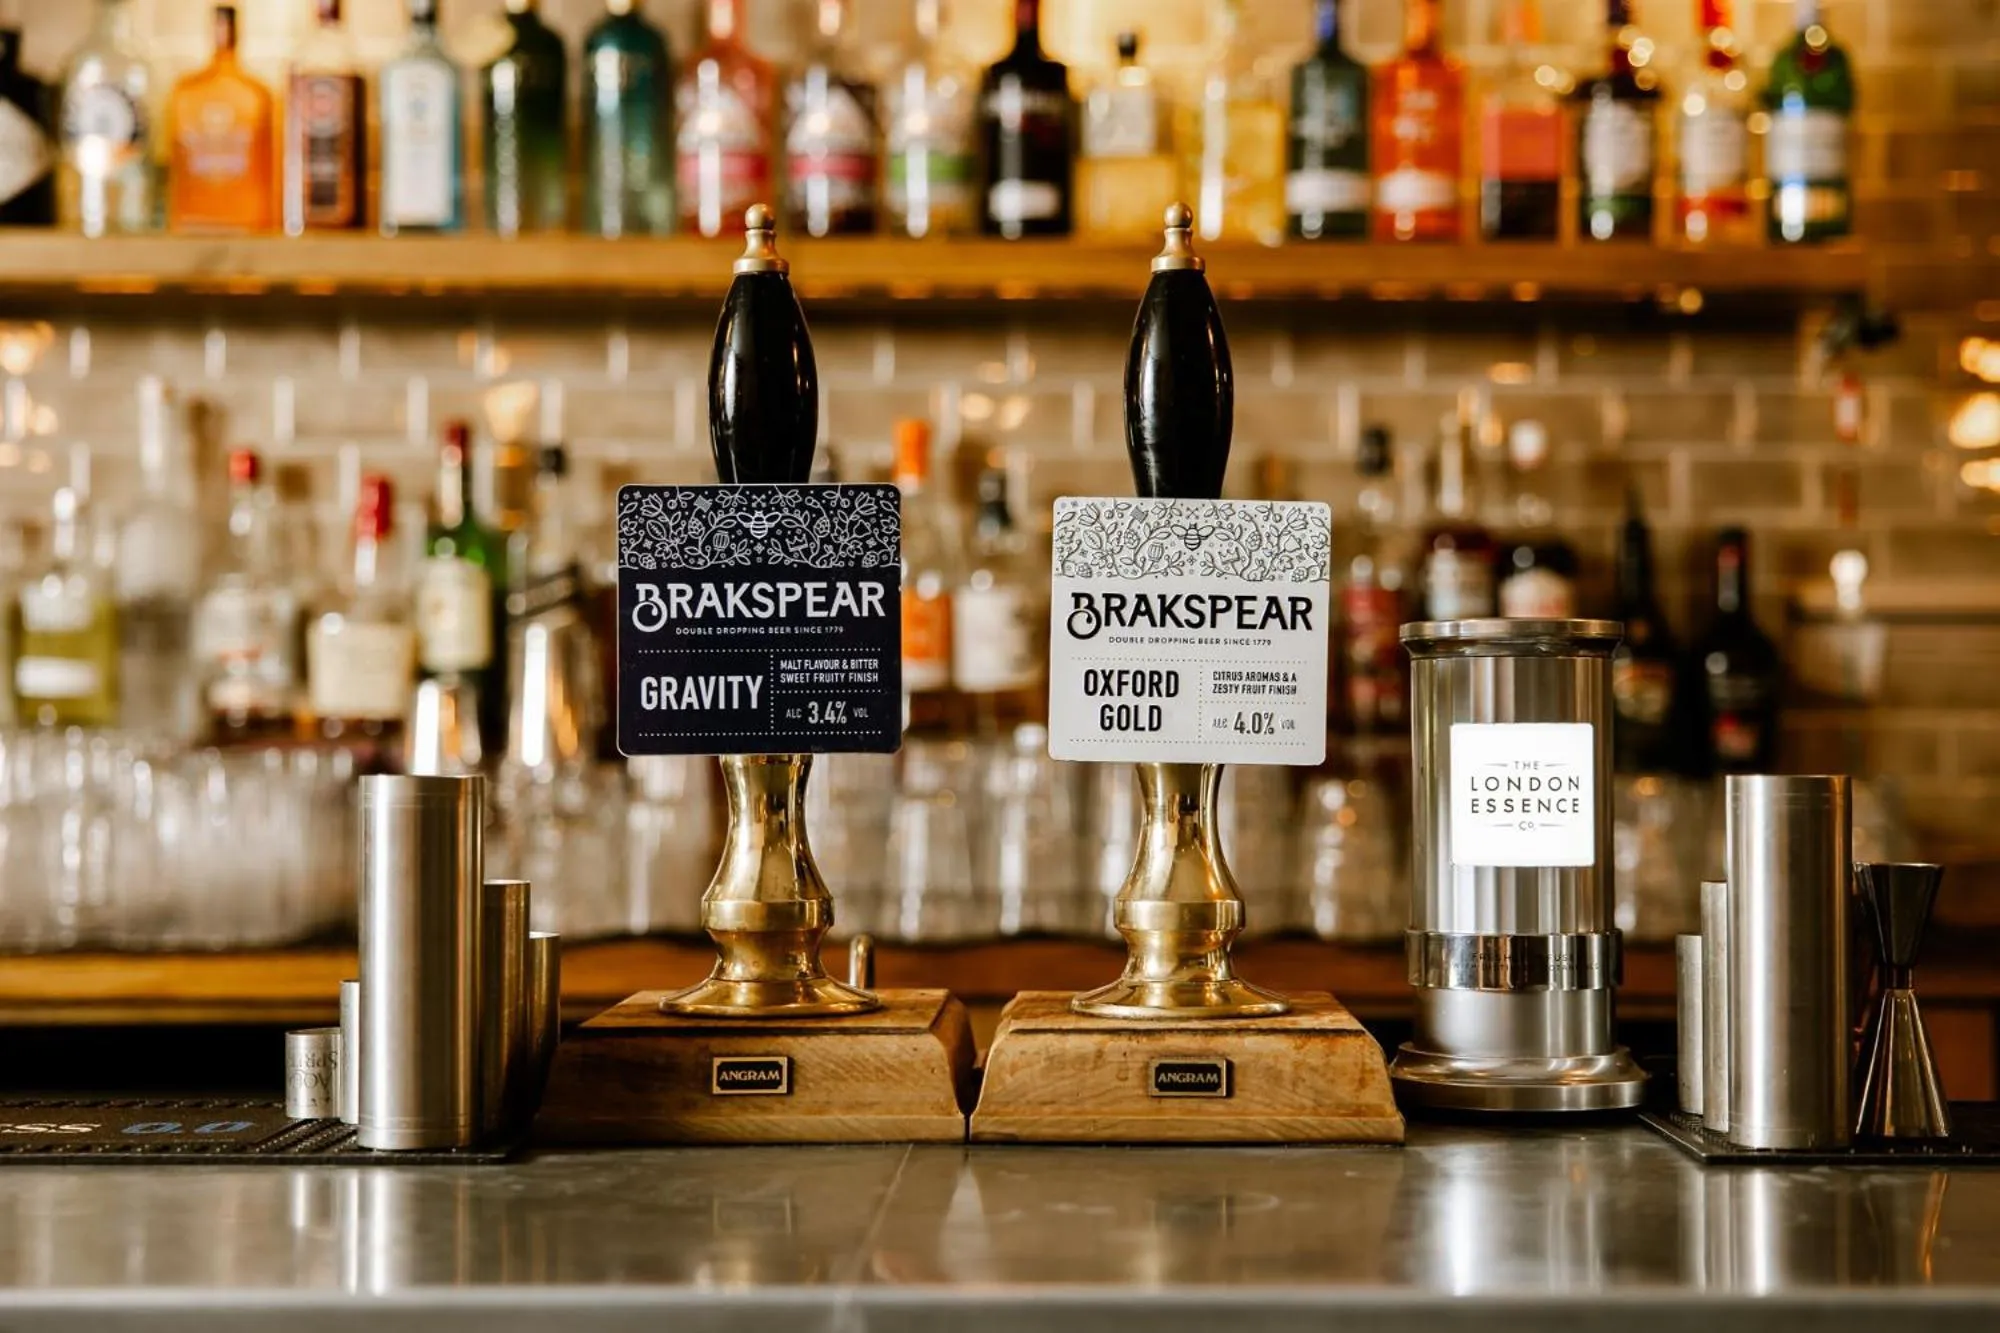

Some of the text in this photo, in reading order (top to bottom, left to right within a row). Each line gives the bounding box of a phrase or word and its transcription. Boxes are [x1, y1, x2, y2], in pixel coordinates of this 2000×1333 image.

[632, 581, 886, 632] BRAKSPEAR
[1067, 592, 1313, 640] BRAKSPEAR
[675, 625, 844, 635] DOUBLE DROPPING BEER SINCE 1779
[1108, 636, 1145, 644] DOUBLE
[1148, 636, 1195, 645] DROPPING
[1198, 637, 1221, 645] BEER
[1223, 638, 1250, 646] SINCE
[780, 659, 879, 670] MALT FLAVOUR & BITTER
[780, 672, 879, 683] SWEET FRUITY FINISH
[1083, 668, 1180, 698] OXFORD
[1212, 671, 1297, 682] CITRUS AROMAS & A
[640, 675, 763, 711] GRAVITY
[1212, 683, 1297, 695] ZESTY FRUIT FINISH
[785, 700, 870, 725] ALC 3.4% VOL
[1100, 703, 1162, 732] GOLD
[1233, 711, 1275, 735] 4.0%
[1513, 760, 1540, 770] THE
[1470, 776, 1580, 792] LONDON
[1471, 797, 1580, 814] ESSENCE
[719, 1069, 781, 1081] ANGRAM
[1157, 1072, 1219, 1084] ANGRAM
